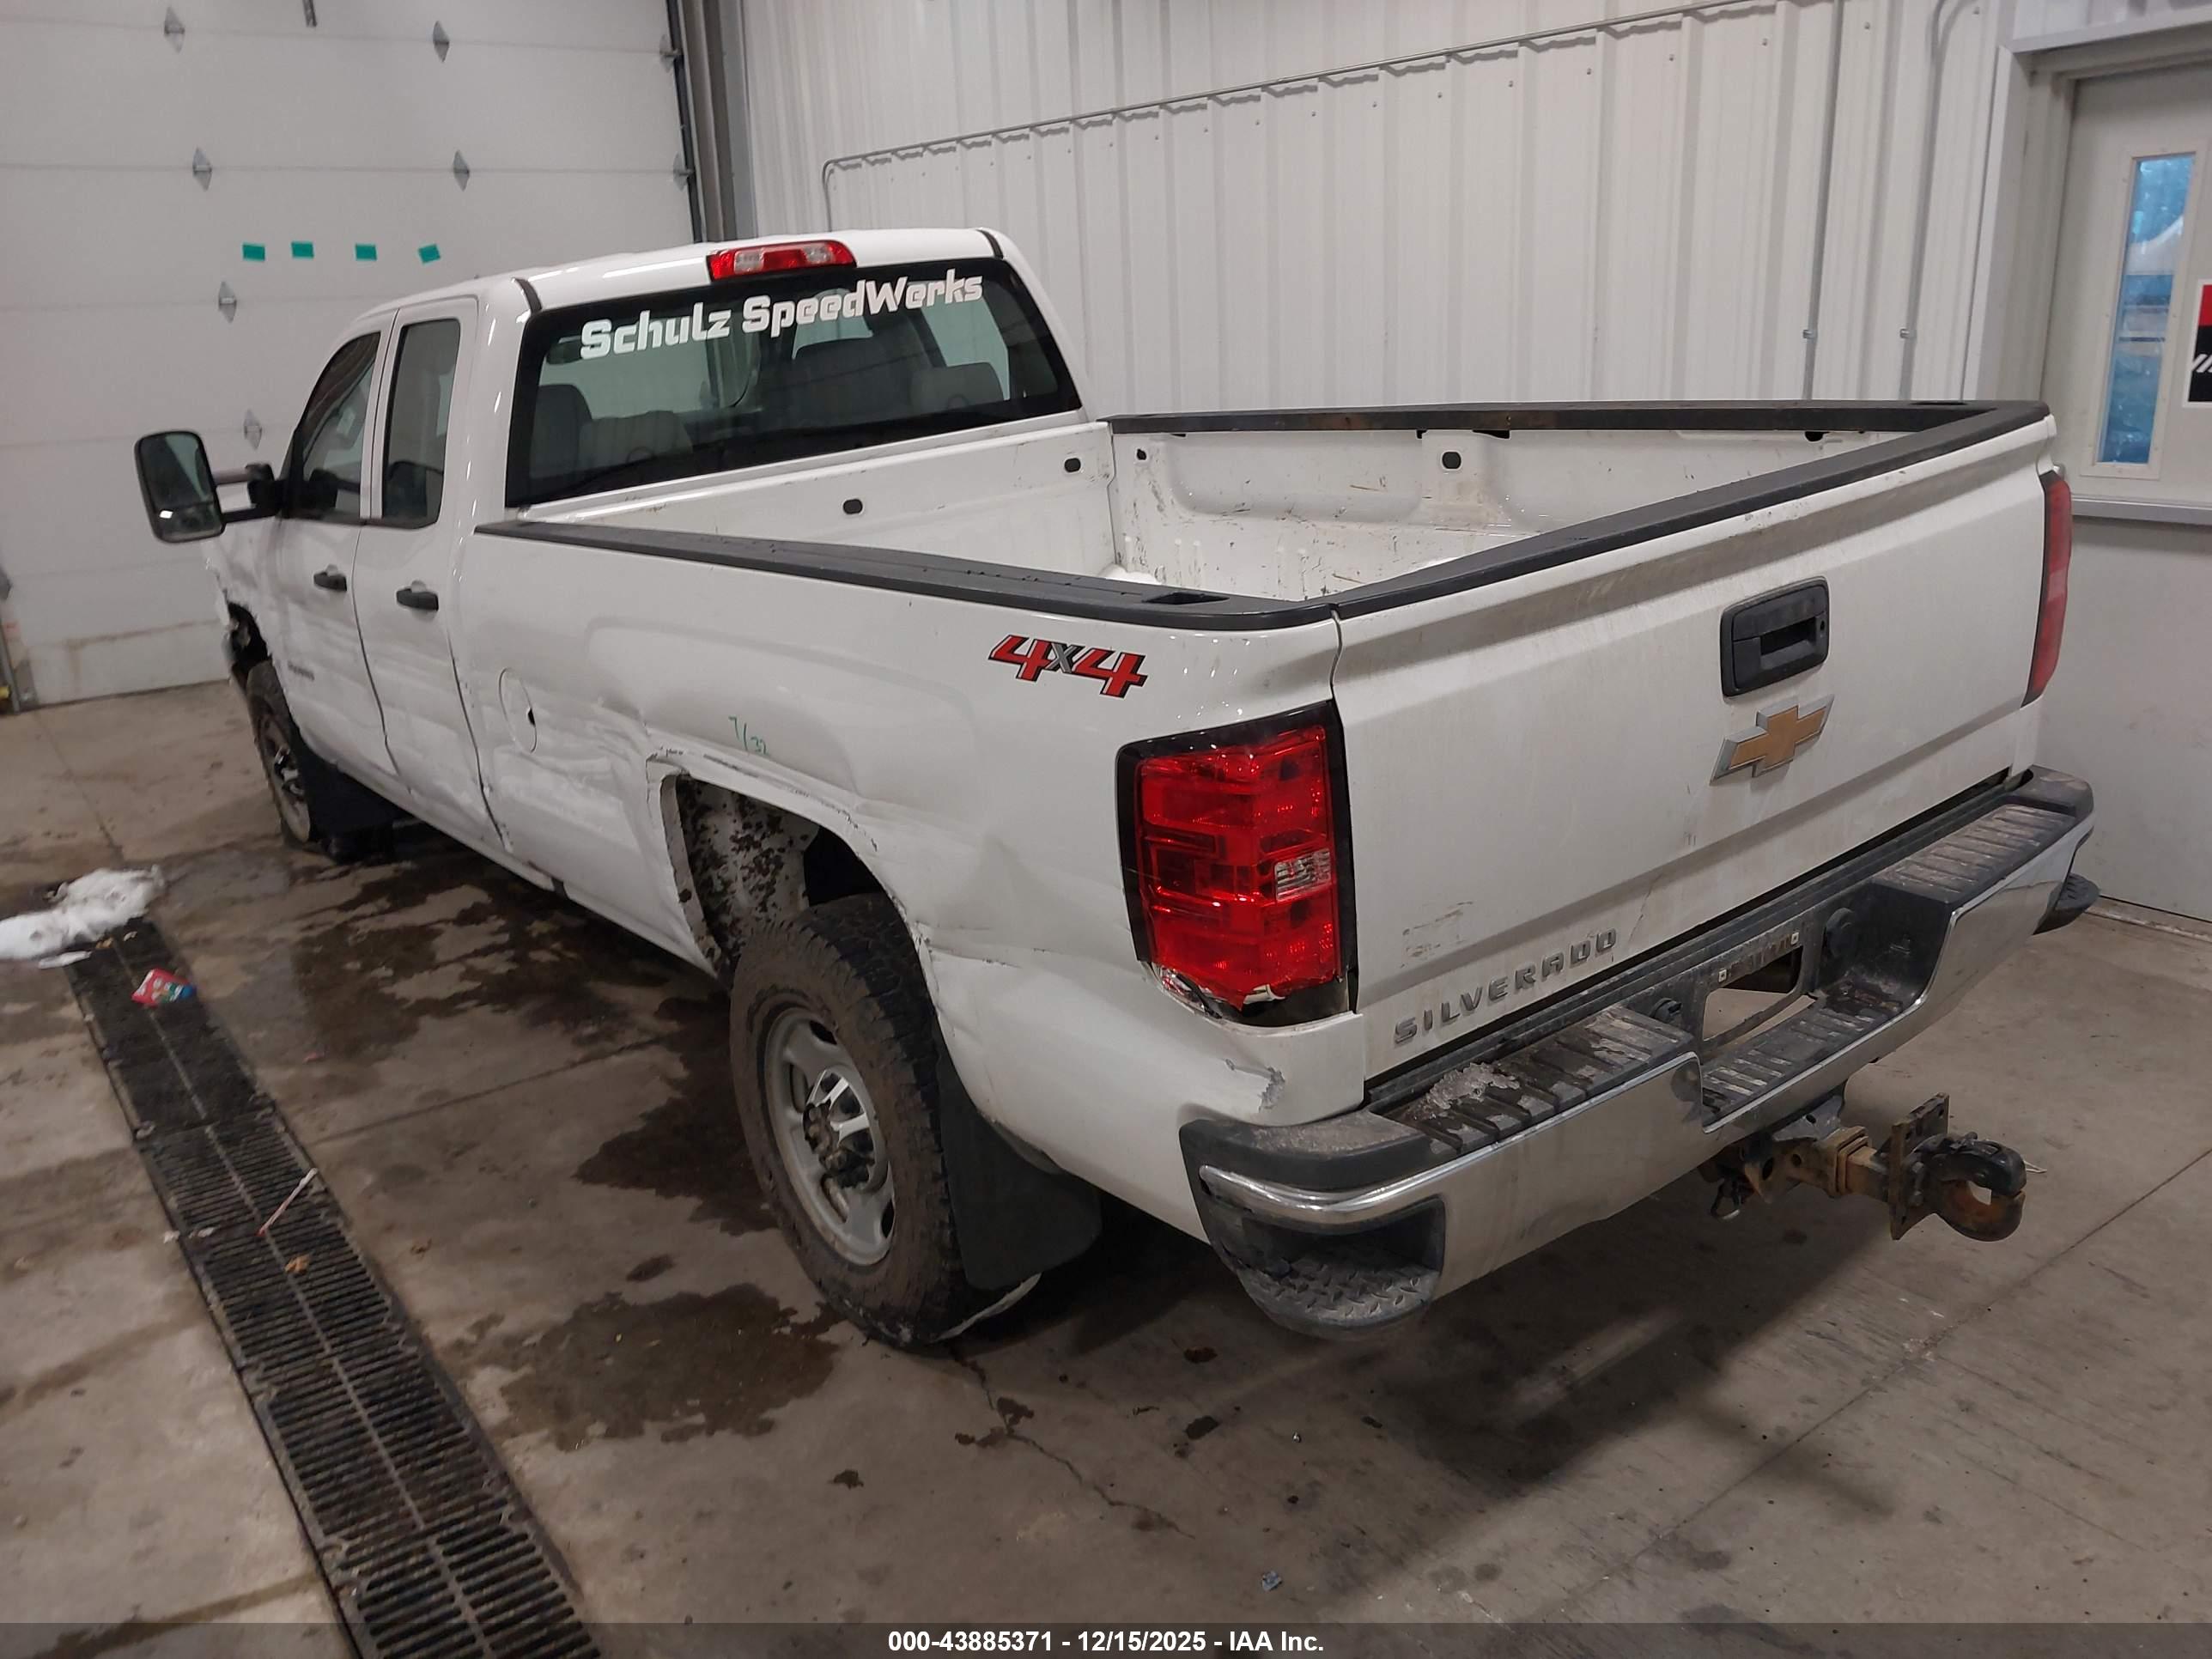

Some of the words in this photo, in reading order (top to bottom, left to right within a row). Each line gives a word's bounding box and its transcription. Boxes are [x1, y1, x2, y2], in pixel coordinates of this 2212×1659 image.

[580, 302, 732, 360] Schulz
[742, 268, 983, 337] SpeedWerks
[1395, 927, 1618, 1045] SILVERADO
